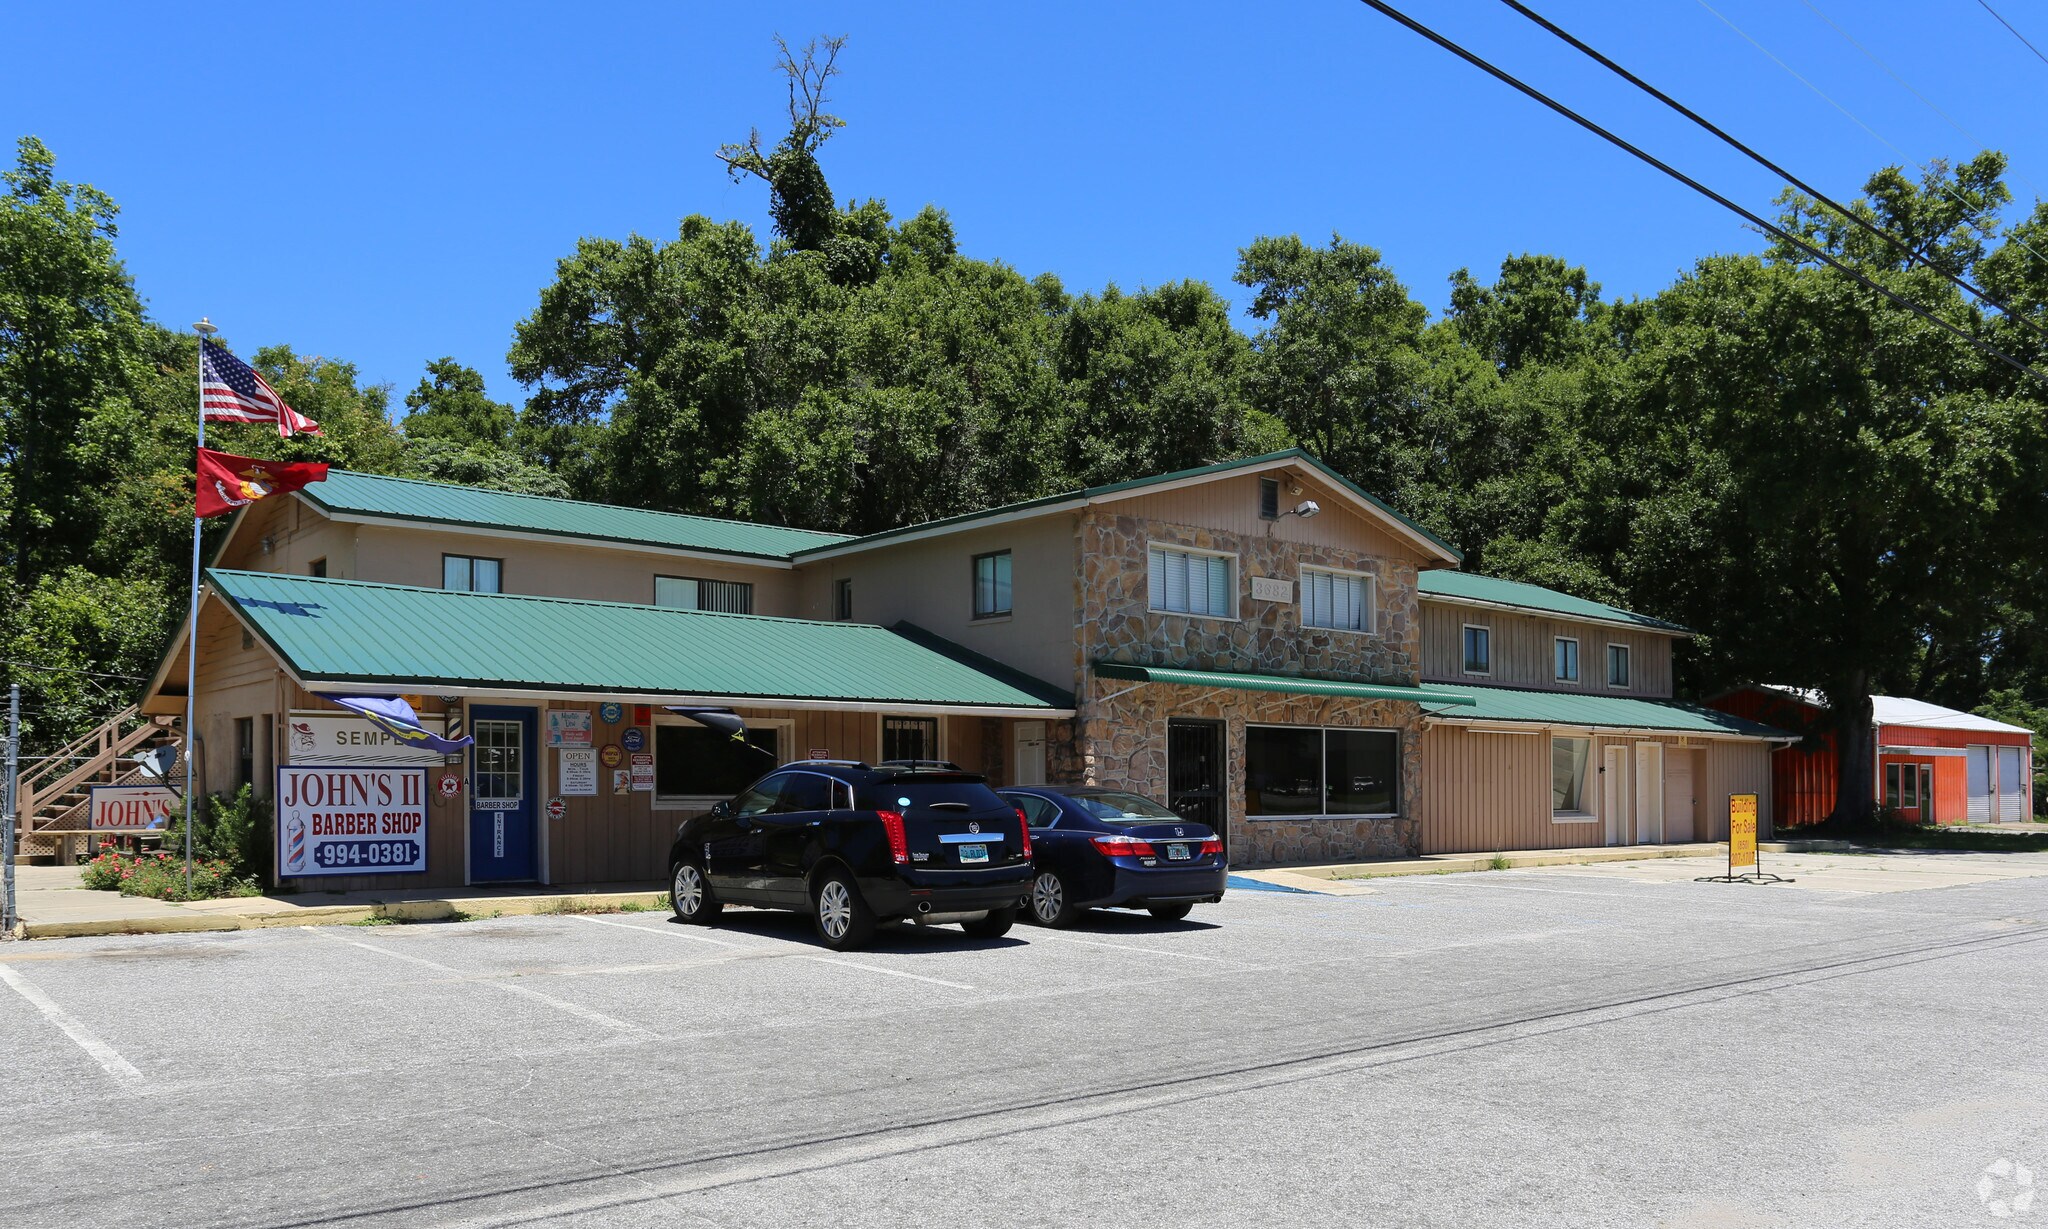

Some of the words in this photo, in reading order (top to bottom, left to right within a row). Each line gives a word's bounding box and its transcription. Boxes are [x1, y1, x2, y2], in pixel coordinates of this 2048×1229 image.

[1256, 582, 1288, 598] 3082
[624, 735, 641, 743] Ford
[565, 752, 591, 760] OPEN
[284, 773, 392, 807] JOHN'S
[401, 774, 421, 806] II
[476, 801, 501, 809] BARBER
[501, 801, 518, 809] SHOP
[1731, 798, 1756, 816] Building
[312, 813, 377, 836] BARBER
[382, 812, 421, 835] SHOP
[1732, 820, 1742, 834] For
[1744, 819, 1755, 833] Sale
[323, 843, 411, 865] 994-0381
